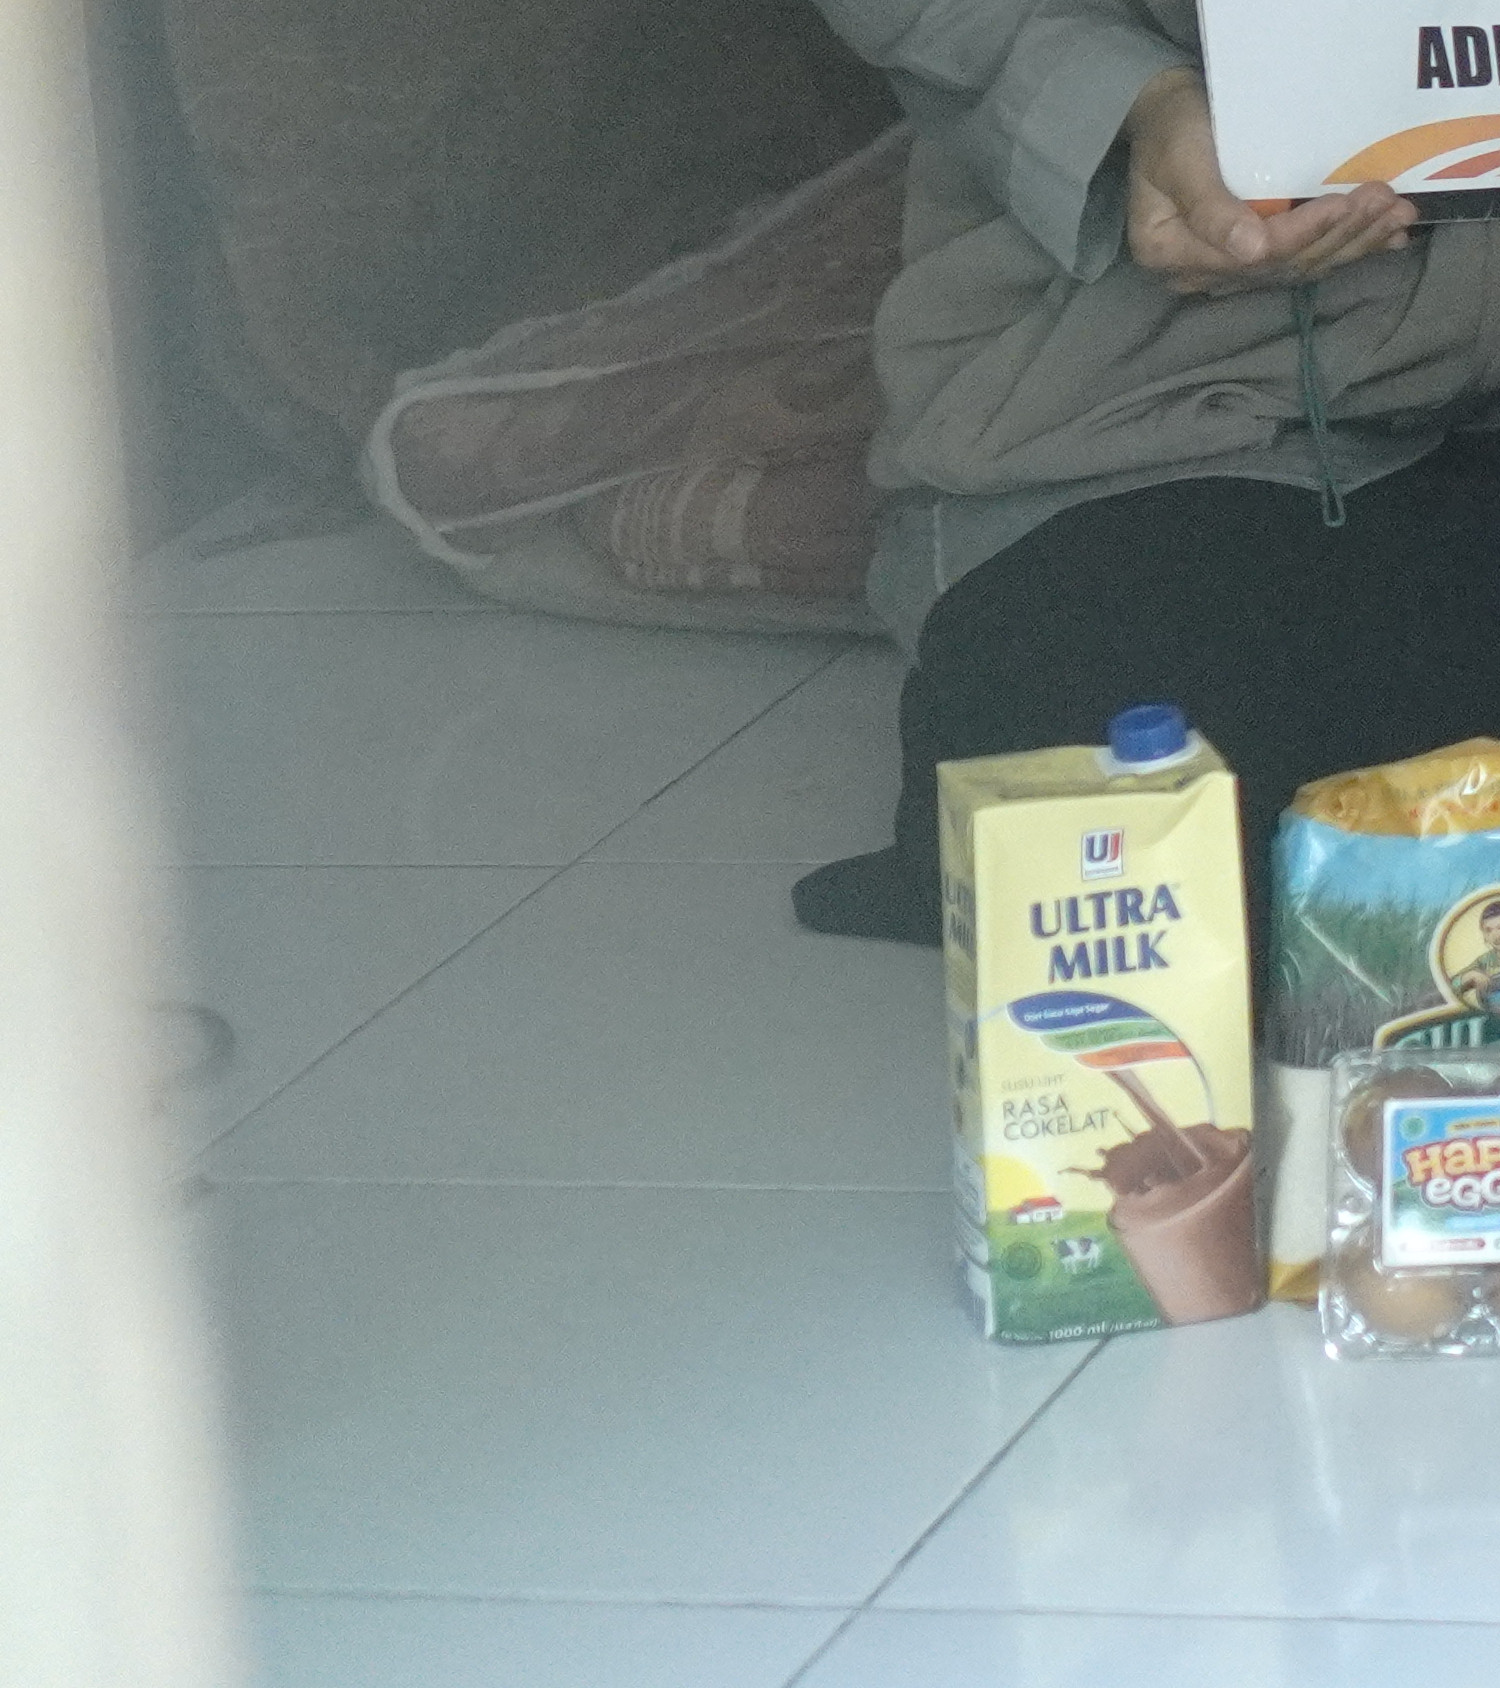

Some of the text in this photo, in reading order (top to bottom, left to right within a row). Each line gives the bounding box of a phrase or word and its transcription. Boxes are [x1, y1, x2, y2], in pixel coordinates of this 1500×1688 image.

[1030, 884, 1182, 938] ULTRA
[1048, 930, 1170, 984] MILK
[1003, 1094, 1069, 1121] RASA
[1003, 1109, 1110, 1141] COKELAT
